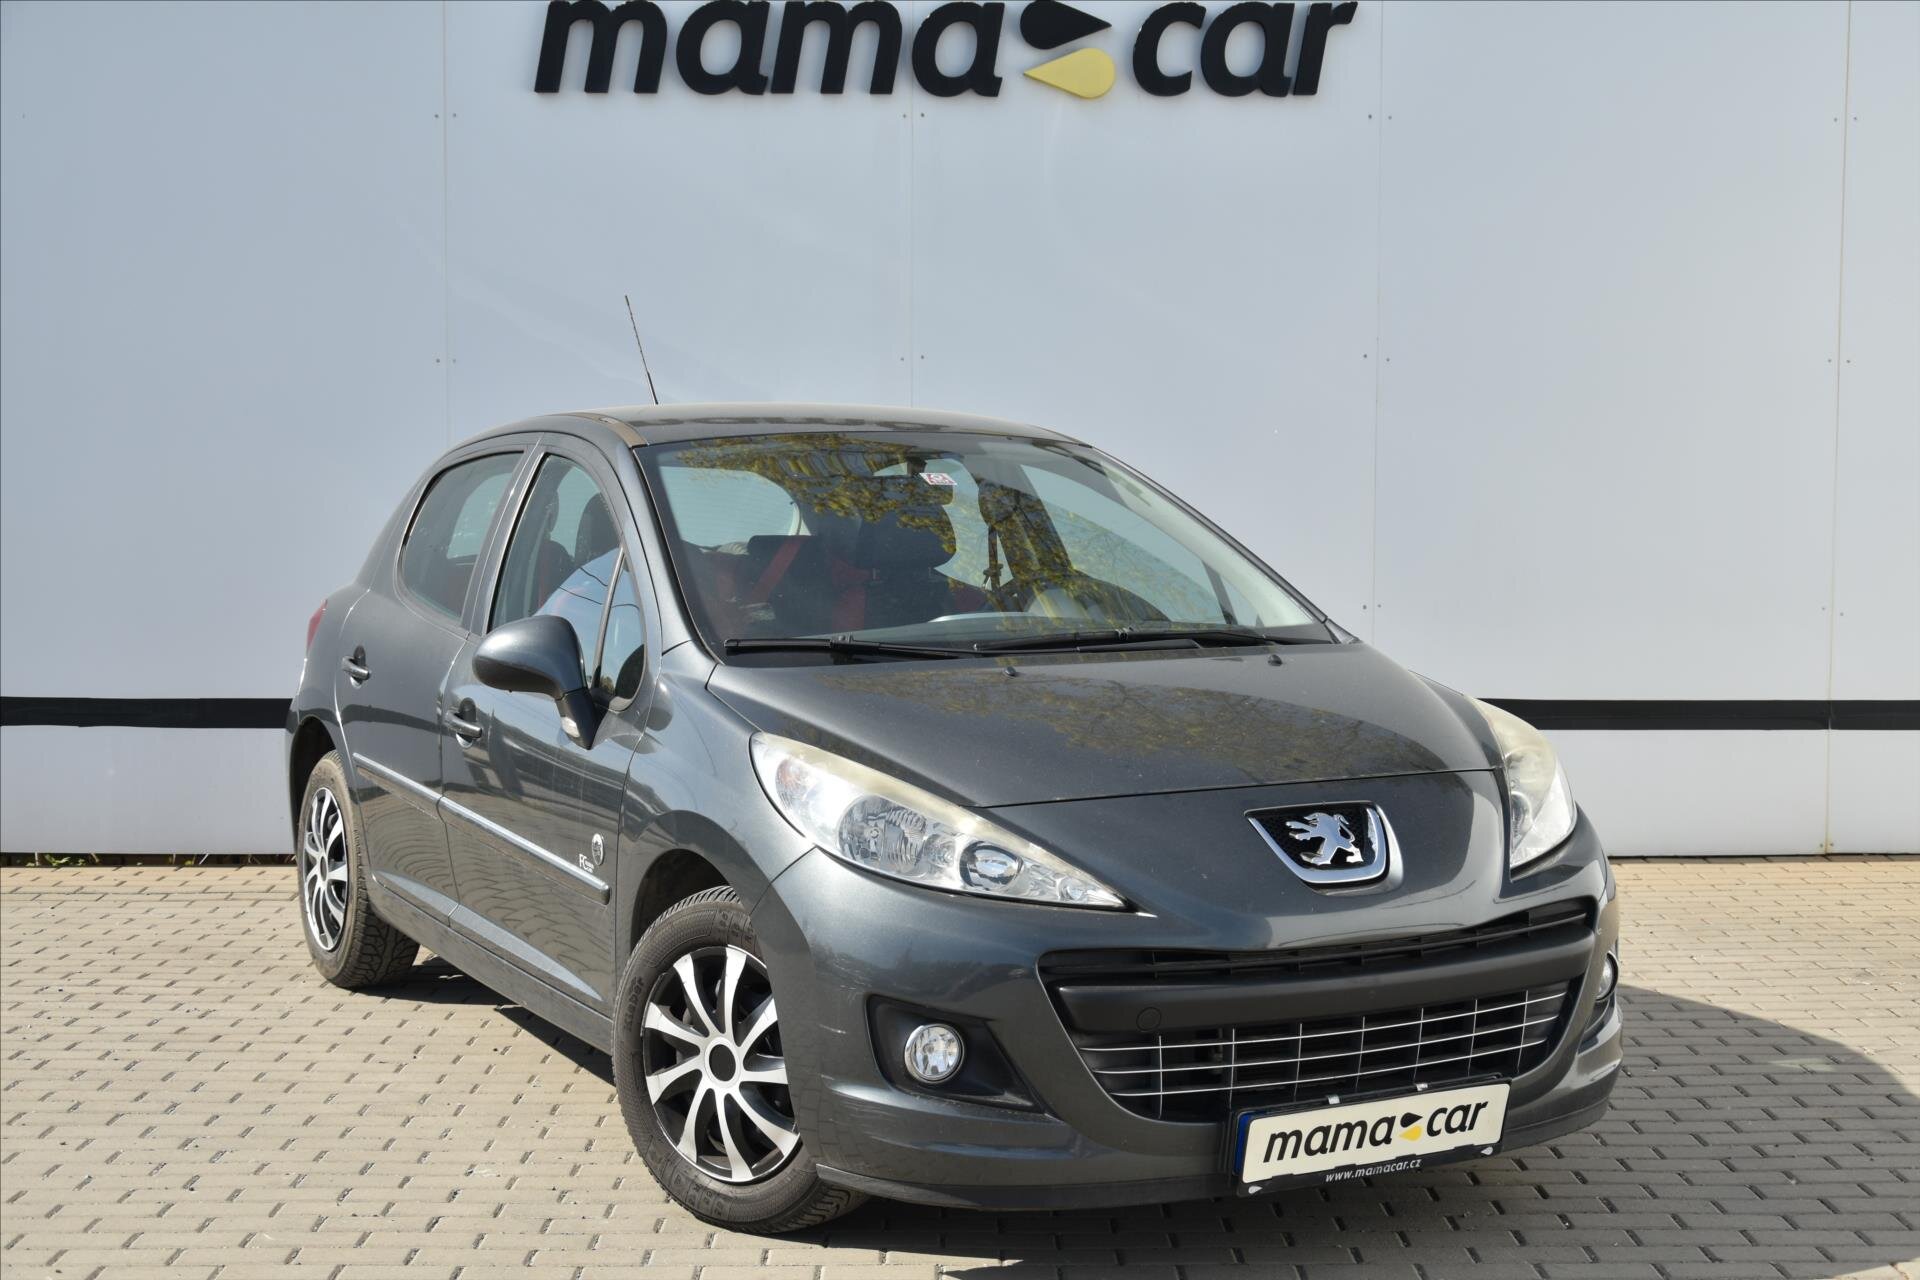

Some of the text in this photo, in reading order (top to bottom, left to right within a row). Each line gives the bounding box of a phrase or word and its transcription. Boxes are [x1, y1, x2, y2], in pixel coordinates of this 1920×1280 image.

[535, 1, 1357, 97] mama car
[1263, 1101, 1488, 1163] mama car
[1325, 1158, 1422, 1183] www.mamacar.cz
